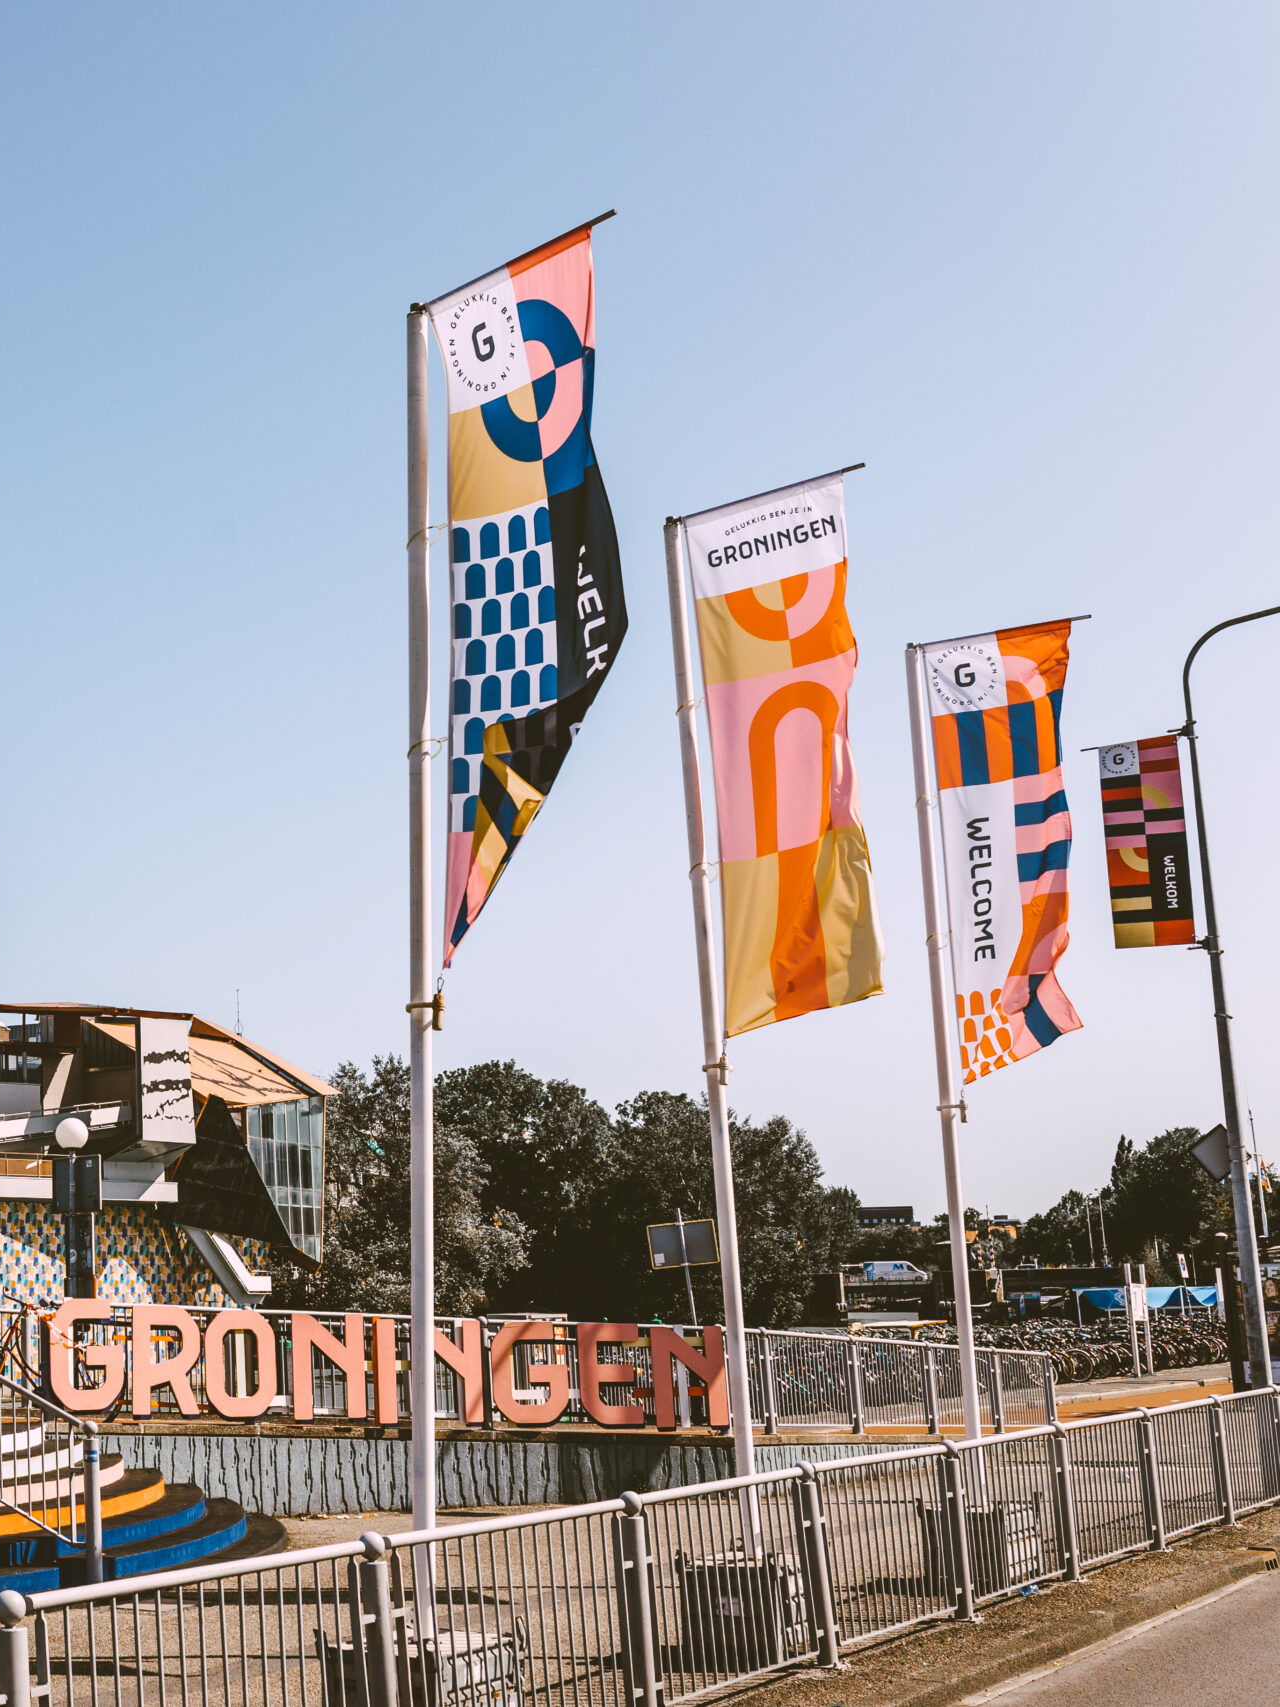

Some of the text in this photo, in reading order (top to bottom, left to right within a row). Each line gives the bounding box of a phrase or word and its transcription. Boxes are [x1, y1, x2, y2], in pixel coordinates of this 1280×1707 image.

[449, 293, 515, 391] GELUKKIG BEN JE IN GRONINGEN
[472, 321, 496, 362] G
[707, 515, 838, 568] GRONINGEN
[724, 515, 767, 536] GELUKKIG
[769, 510, 786, 519] BEN
[789, 507, 800, 515] JE
[932, 645, 997, 705] GELUKKIG BEN JE IN GRONINGEN
[954, 663, 976, 688] G
[1113, 753, 1124, 765] G
[966, 816, 996, 962] WELCOME
[1163, 855, 1179, 909] WELKOM
[49, 1298, 730, 1429] GRONINGEN
